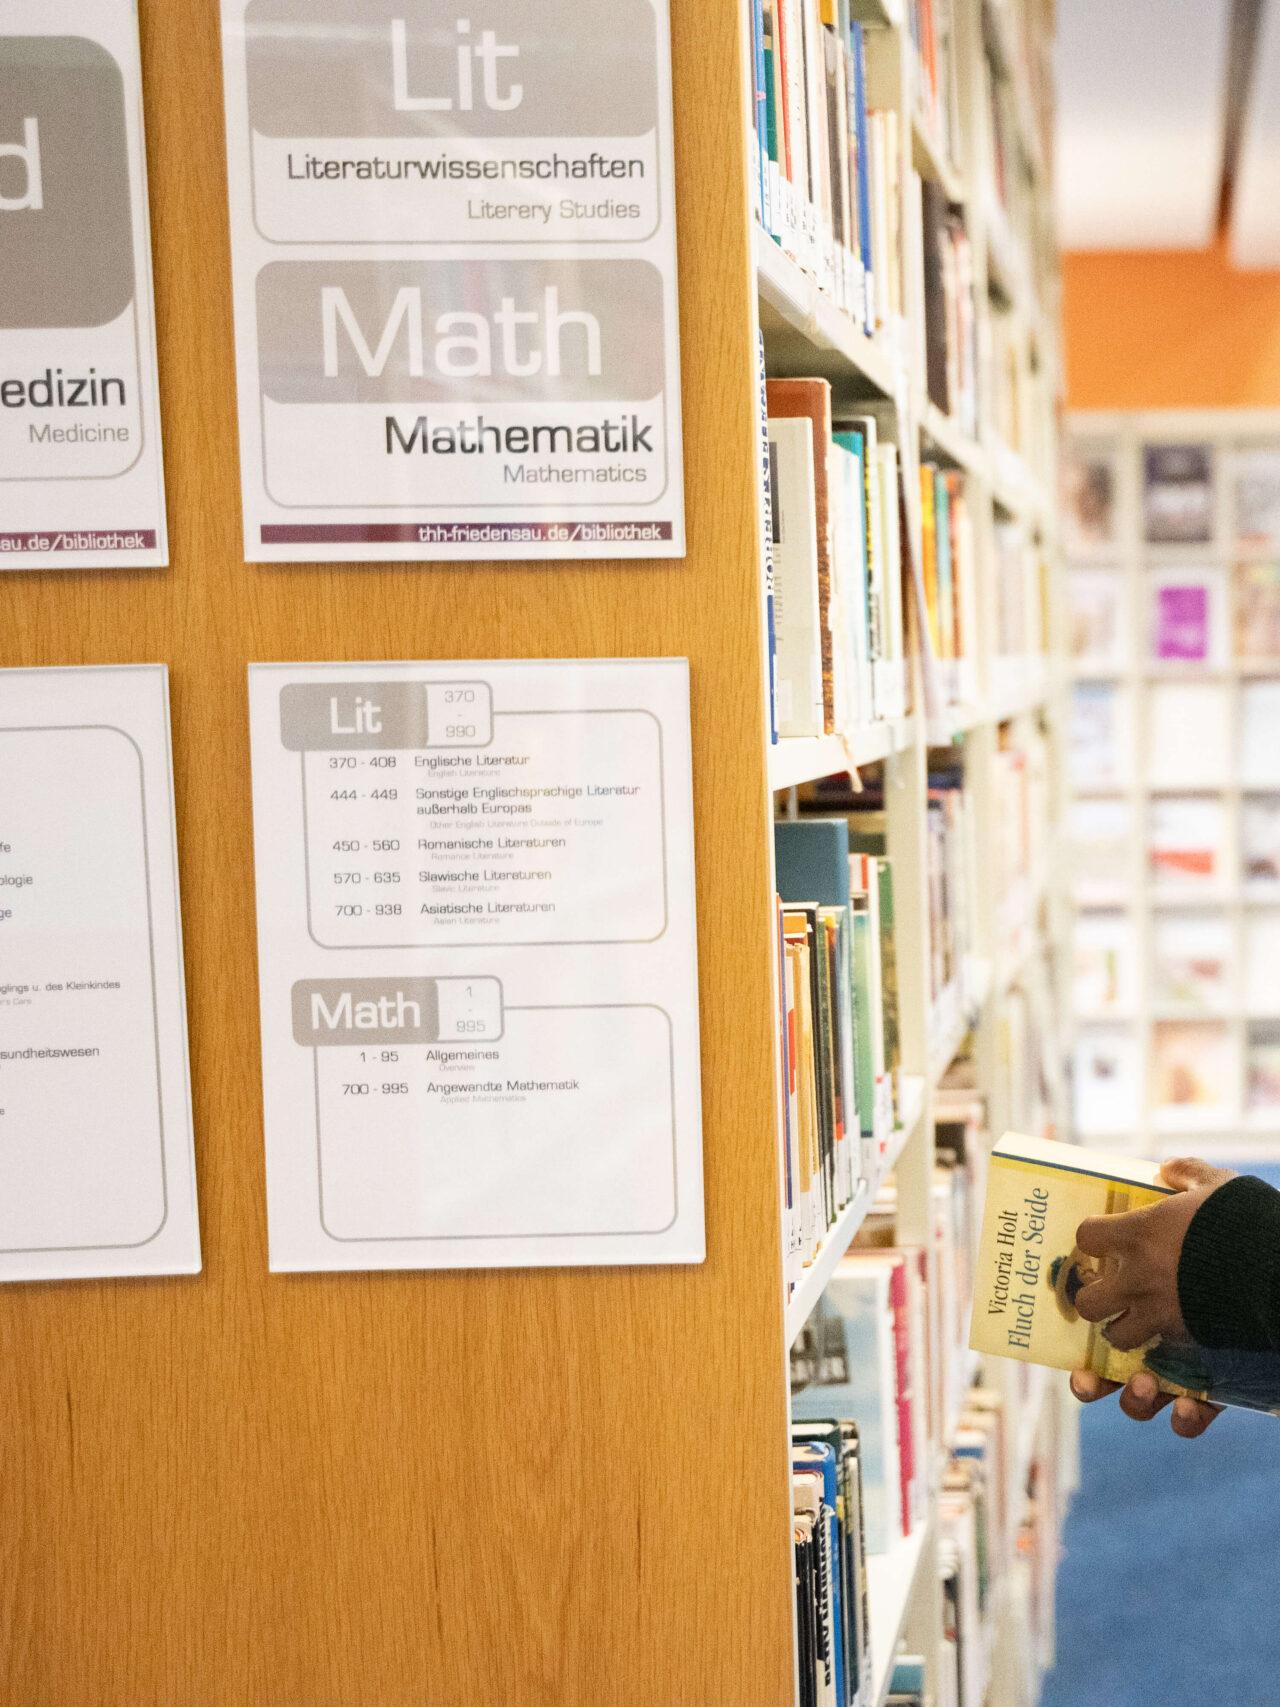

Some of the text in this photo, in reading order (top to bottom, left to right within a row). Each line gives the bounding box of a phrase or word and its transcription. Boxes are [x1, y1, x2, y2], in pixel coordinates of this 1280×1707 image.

[391, 19, 523, 111] Lit
[288, 153, 645, 180] Literaturwissenschaften
[468, 199, 641, 224] Literery Studies
[321, 286, 601, 379] Math
[0, 368, 126, 408] edizin
[29, 423, 129, 443] Medicine
[386, 415, 653, 455] Mathematik
[504, 463, 647, 483] Mathematics
[419, 524, 662, 542] thh-friedensau.de/bibliothek
[444, 690, 475, 703] 370
[331, 696, 382, 734] Lit
[445, 725, 476, 738] 990
[329, 757, 357, 768] 370
[369, 756, 397, 768] 408
[414, 755, 472, 769] Englische
[477, 755, 530, 766] Literatur
[330, 789, 357, 800] 444
[370, 789, 398, 800] 449
[416, 787, 469, 801] Sonstige
[473, 786, 583, 800] Englischsprachige
[587, 784, 641, 796] Literatur
[416, 803, 533, 816] außerhalb Europas
[332, 840, 360, 851] 450
[372, 839, 400, 851] 560
[418, 838, 494, 850] Romanische
[498, 837, 566, 848] Literaturen
[333, 872, 361, 884] 570
[374, 871, 401, 883] 635
[418, 870, 479, 882] Slawische
[484, 869, 552, 881] Literaturen
[335, 905, 363, 916] 700
[375, 904, 402, 915] 938
[421, 903, 484, 914] Asiatische
[487, 901, 556, 913] Literaturen
[0, 983, 29, 995] glings
[45, 982, 63, 991] des
[66, 980, 121, 990] Kleinkindes
[466, 986, 473, 998] 1
[311, 991, 421, 1030] Math
[456, 1020, 486, 1033] 995
[360, 1051, 367, 1062] 1
[381, 1051, 399, 1062] 95
[426, 1049, 500, 1063] Allgemeines
[342, 1083, 370, 1095] 700
[382, 1082, 409, 1095] 995
[427, 1081, 503, 1096] Angewandte
[506, 1079, 580, 1092] Mathematik
[988, 1209, 1018, 1316] Victoria Holt
[1007, 1187, 1049, 1350] Fluch der Seide
